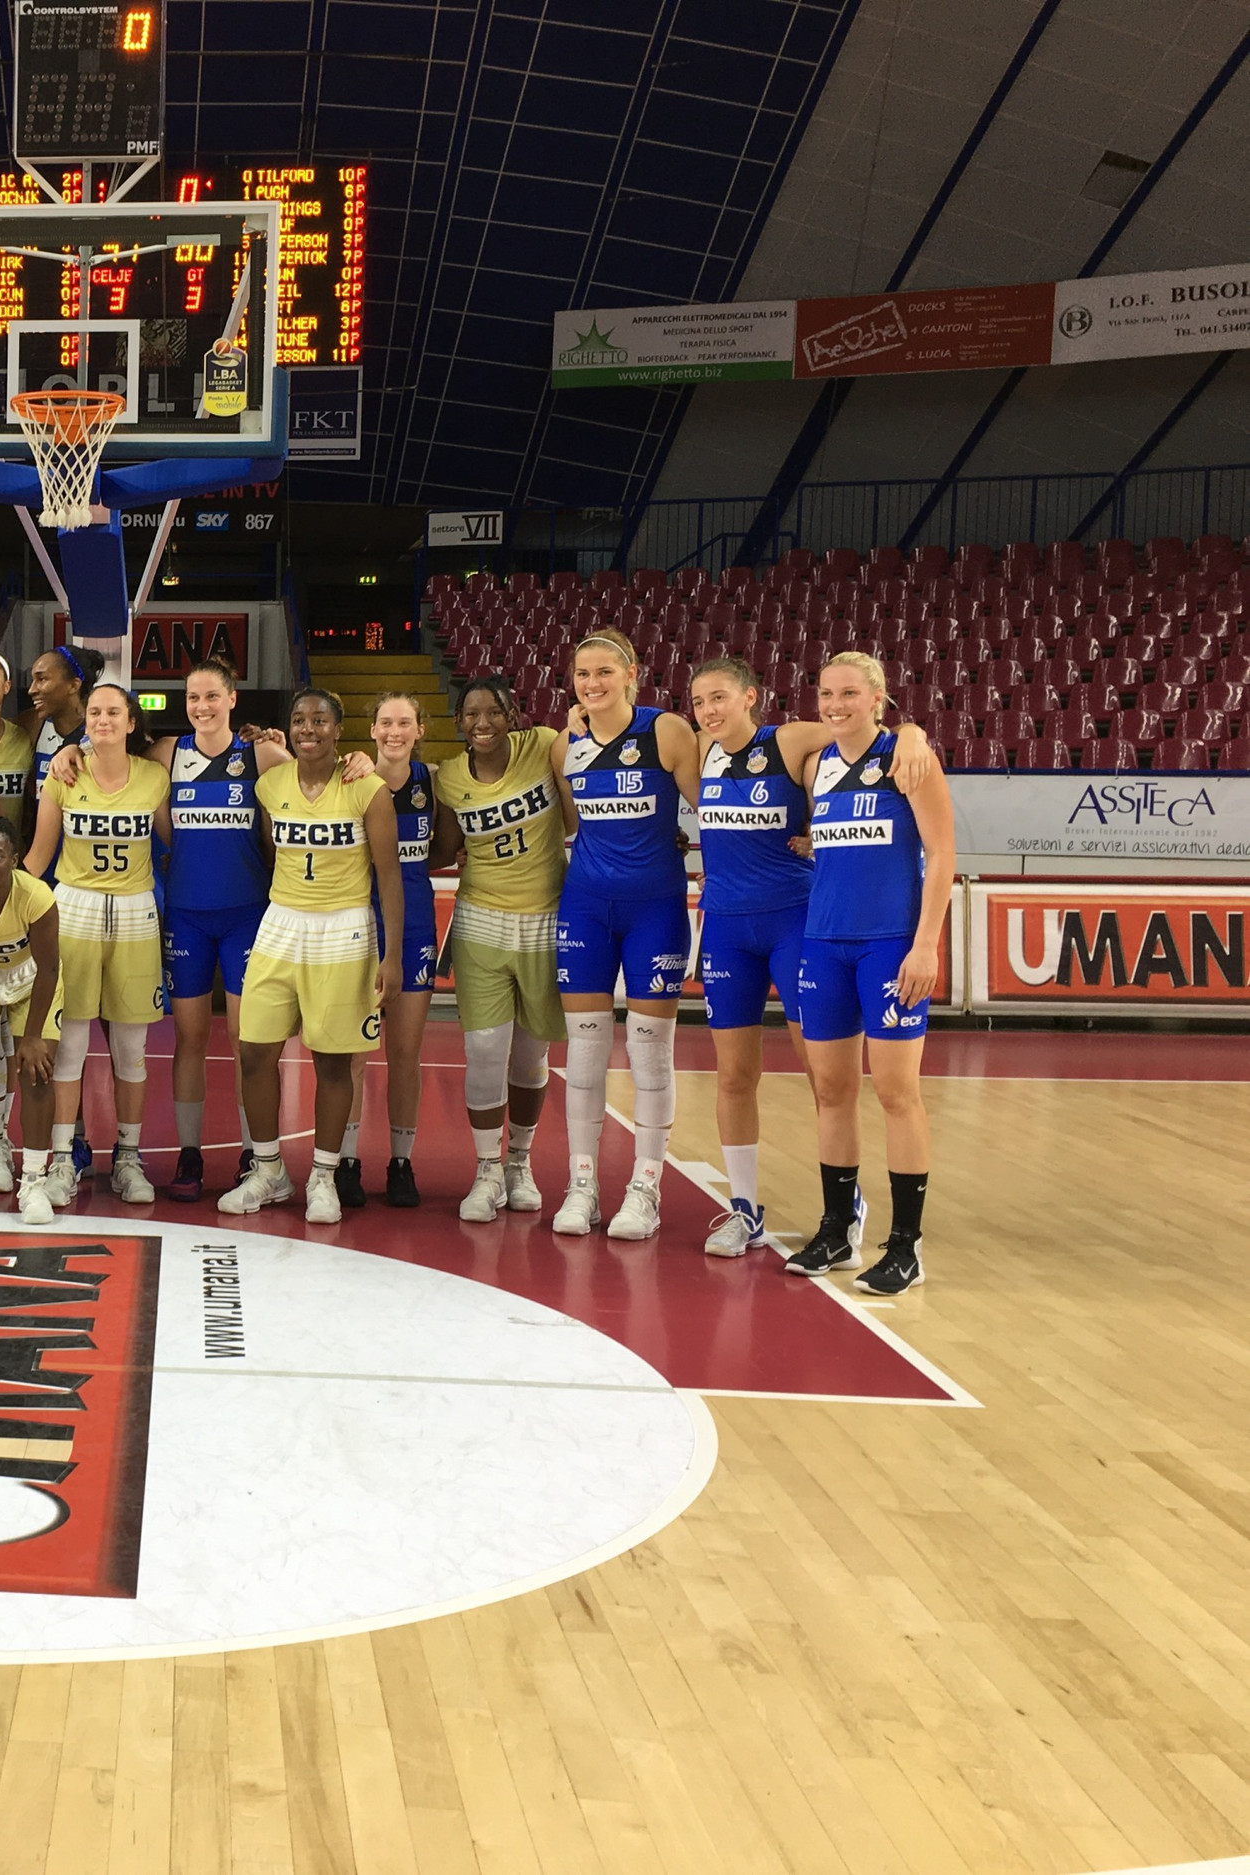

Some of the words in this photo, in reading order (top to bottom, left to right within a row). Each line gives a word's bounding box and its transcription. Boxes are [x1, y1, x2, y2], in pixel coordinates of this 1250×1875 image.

[34, 6, 119, 15] CONTROLSYSTEM
[124, 13, 150, 50] 0
[127, 141, 159, 155] PMF
[256, 169, 315, 183] TILFORD
[255, 185, 290, 200] PUGH
[92, 269, 134, 283] CELJE
[187, 268, 205, 282] GT
[110, 286, 126, 312] 3
[185, 285, 202, 311] 3
[907, 301, 946, 313] DOCKS
[631, 316, 681, 325] APPARECCHI
[682, 314, 751, 323] ELETTROMEDICALI
[752, 312, 768, 321] DAL
[662, 327, 706, 337] MEDICINA
[707, 326, 728, 336] DELLO
[728, 324, 753, 334] SPORT
[910, 325, 918, 335] 4
[921, 322, 973, 335] CANTONI
[679, 340, 711, 350] TERAPIA
[712, 338, 737, 348] FISICA
[558, 349, 629, 367] RIGHETTO
[637, 353, 689, 364] BIOFEEDBACK
[697, 352, 718, 362] PEAK
[719, 350, 777, 361] PERFORMANCE
[917, 348, 951, 360] LUCIA
[213, 369, 239, 380] LBA
[617, 366, 723, 383] www.righetto.biz
[292, 410, 355, 430] FKT
[251, 480, 281, 500] TV
[195, 512, 229, 528] SKY
[244, 513, 275, 531] 867
[431, 524, 465, 535] settore
[461, 513, 500, 542] VII
[134, 621, 238, 671] ANA
[616, 770, 645, 794] 15
[227, 783, 244, 805] 3
[750, 779, 769, 805] 6
[460, 783, 550, 834] TECH
[852, 793, 878, 817] 11
[1066, 782, 1216, 828] ASSITECA
[69, 811, 152, 838] TECH
[178, 812, 251, 831] CINKARNA
[418, 817, 431, 838] 5
[702, 810, 782, 828] CINKARNA
[271, 820, 356, 847] TECH
[493, 827, 529, 860] 21
[1006, 838, 1062, 852] soluzioni
[1066, 840, 1075, 851] e
[1080, 839, 1127, 853] servizi
[1131, 841, 1210, 855] assicurativi
[92, 843, 130, 873] 55
[303, 852, 316, 882] 1
[1006, 908, 1250, 988] UMAN
[900, 1014, 922, 1028] ece
[191, 1244, 246, 1359] www.umana.it
